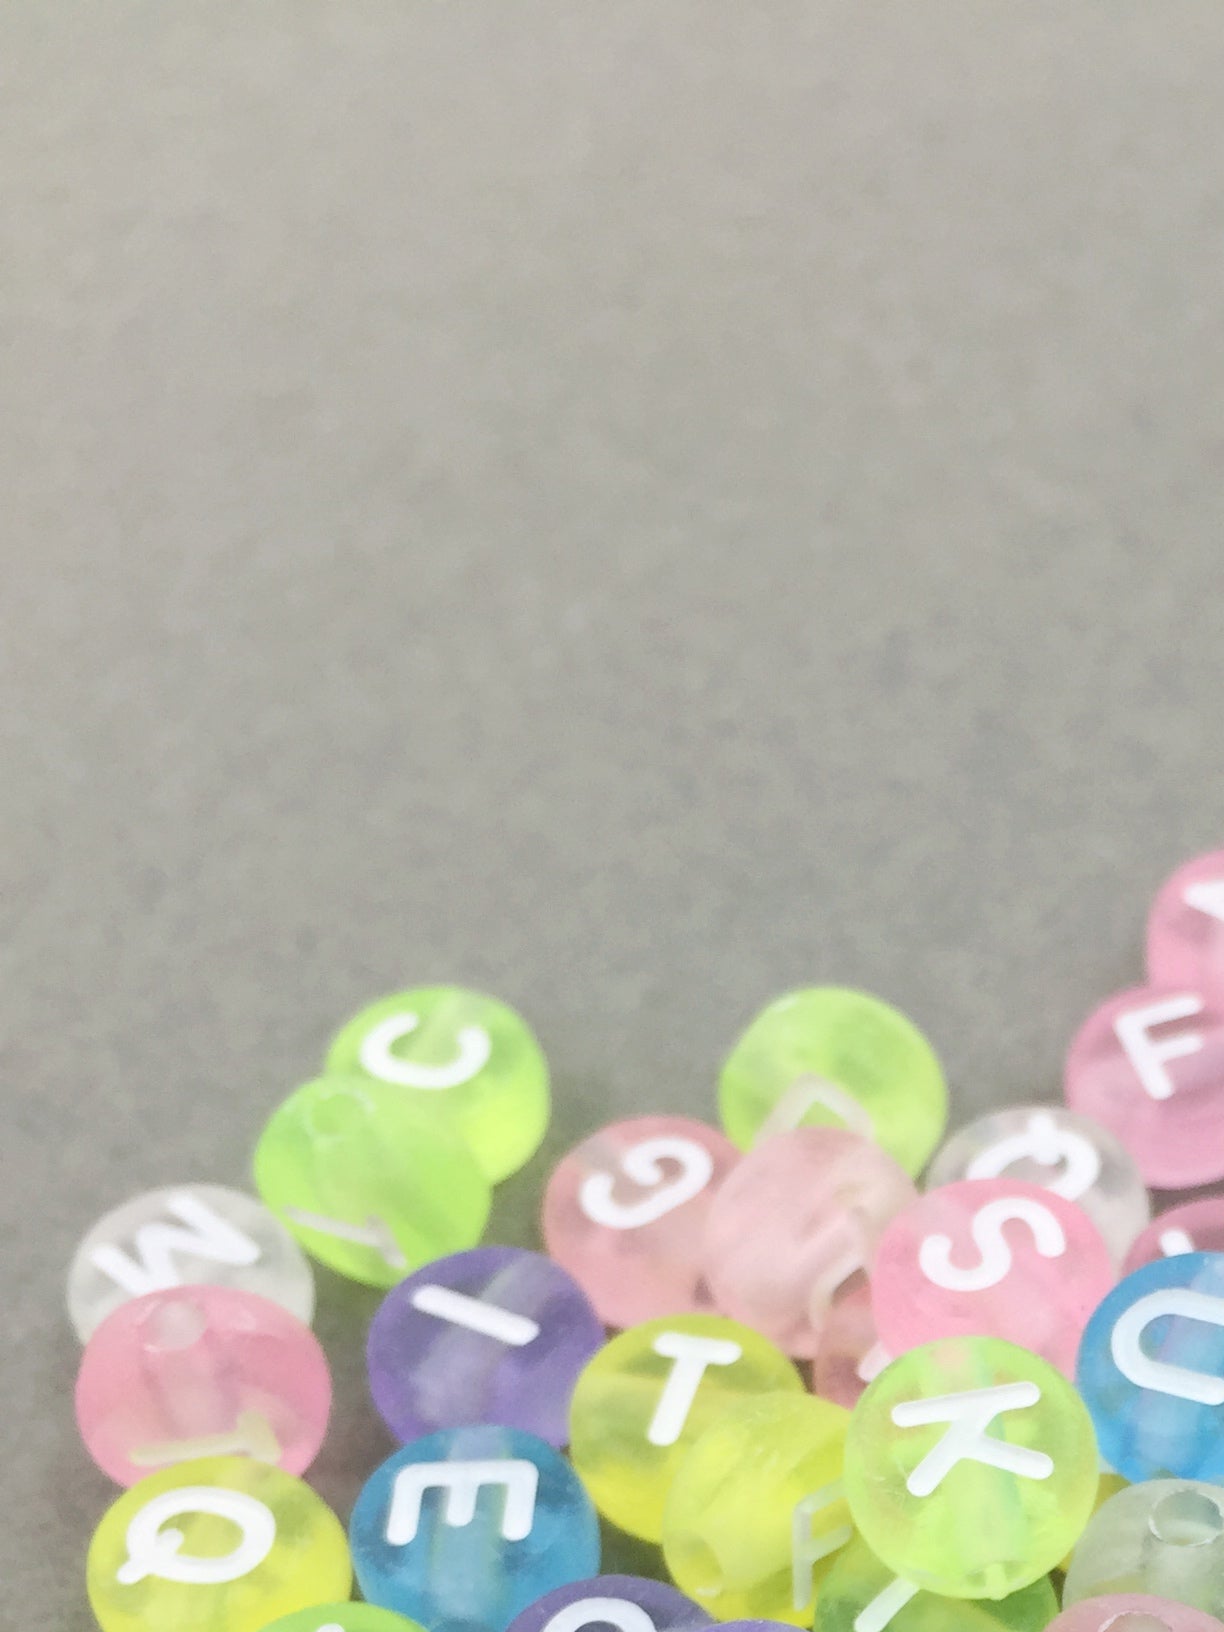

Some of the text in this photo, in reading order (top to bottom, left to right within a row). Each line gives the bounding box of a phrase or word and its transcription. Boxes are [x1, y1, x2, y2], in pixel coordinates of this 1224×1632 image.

[361, 1015, 488, 1087] C
[1116, 996, 1203, 1099] F
[581, 1137, 712, 1229] G
[919, 1198, 1065, 1291] S
[650, 1334, 740, 1444] T
[892, 1382, 1053, 1496] K
[118, 1488, 274, 1583] Q
[388, 1462, 536, 1544] E
